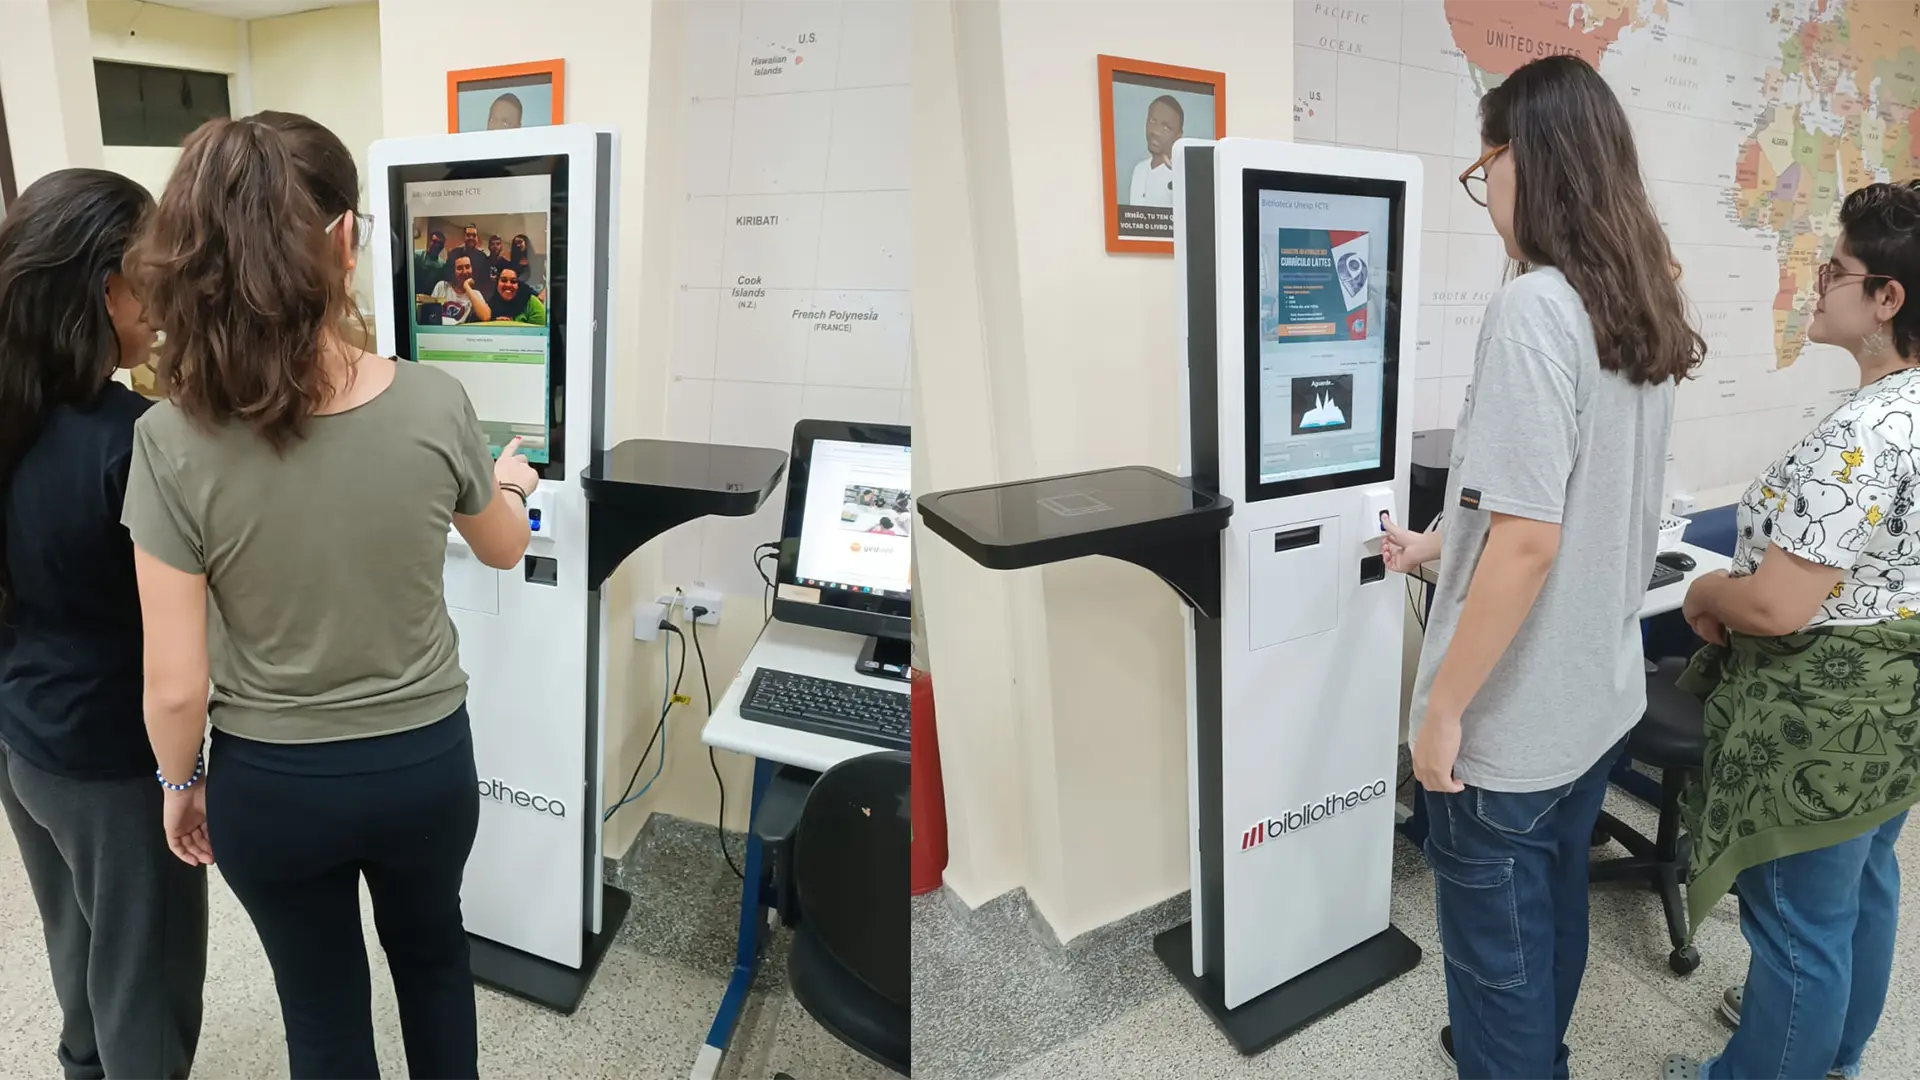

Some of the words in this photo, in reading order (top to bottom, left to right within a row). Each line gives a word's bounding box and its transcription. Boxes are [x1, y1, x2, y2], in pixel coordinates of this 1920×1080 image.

[1315, 4, 1369, 24] PACIFIC
[798, 33, 817, 43] U.S.
[1486, 29, 1533, 54] UNITED
[1319, 36, 1362, 54] OCEAN
[751, 55, 787, 65] Hawaiian
[444, 189, 463, 197] Unesp
[736, 216, 779, 226] KIRIBATI
[1311, 257, 1331, 267] LATTES
[737, 275, 762, 285] Cook
[731, 288, 766, 298] Islands
[1433, 291, 1467, 301] SOUTH
[791, 309, 826, 319] French
[828, 310, 879, 322] Polynesia
[1455, 316, 1481, 325] OCEA
[813, 323, 852, 333] (FRANCE)
[478, 779, 565, 818] otheca
[1268, 780, 1386, 838] bibliotheca
